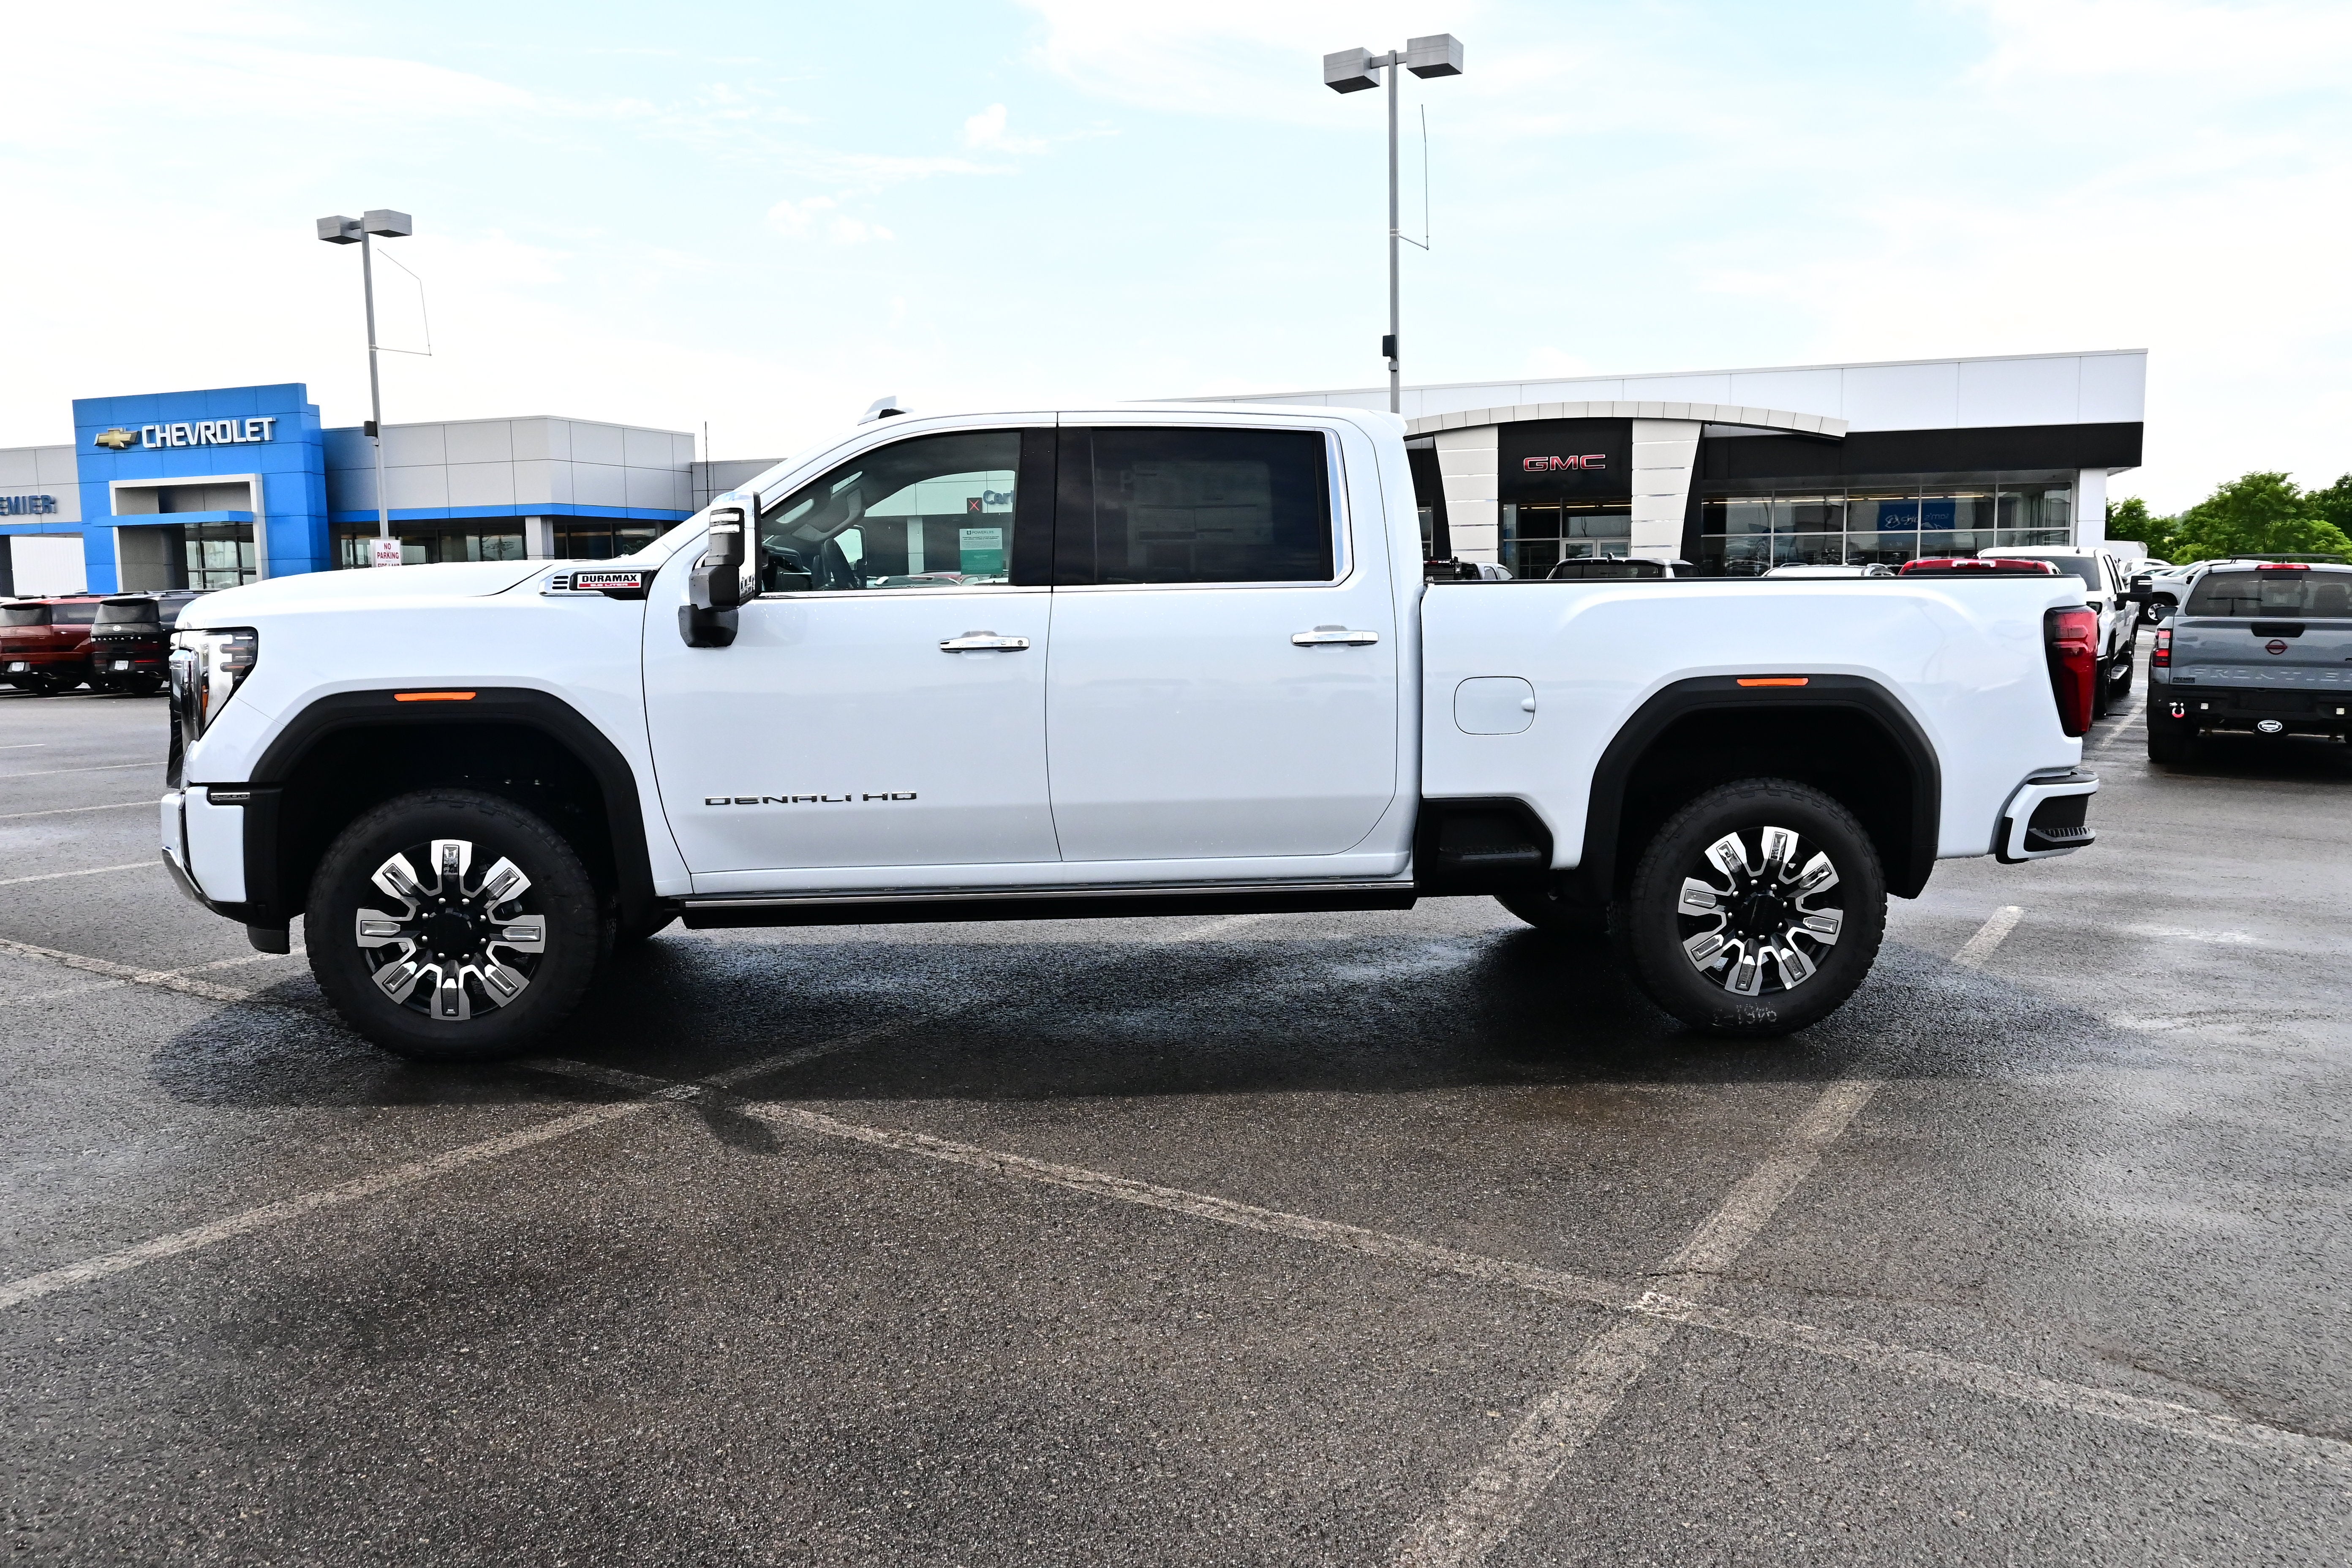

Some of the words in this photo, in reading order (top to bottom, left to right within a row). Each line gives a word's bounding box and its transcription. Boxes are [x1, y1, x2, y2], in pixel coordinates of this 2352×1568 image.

[142, 417, 276, 448] CHEVROLET
[1523, 454, 1606, 472] GMC
[582, 574, 637, 583] DURAMAX
[705, 792, 852, 805] DENALI
[863, 791, 917, 801] HD
